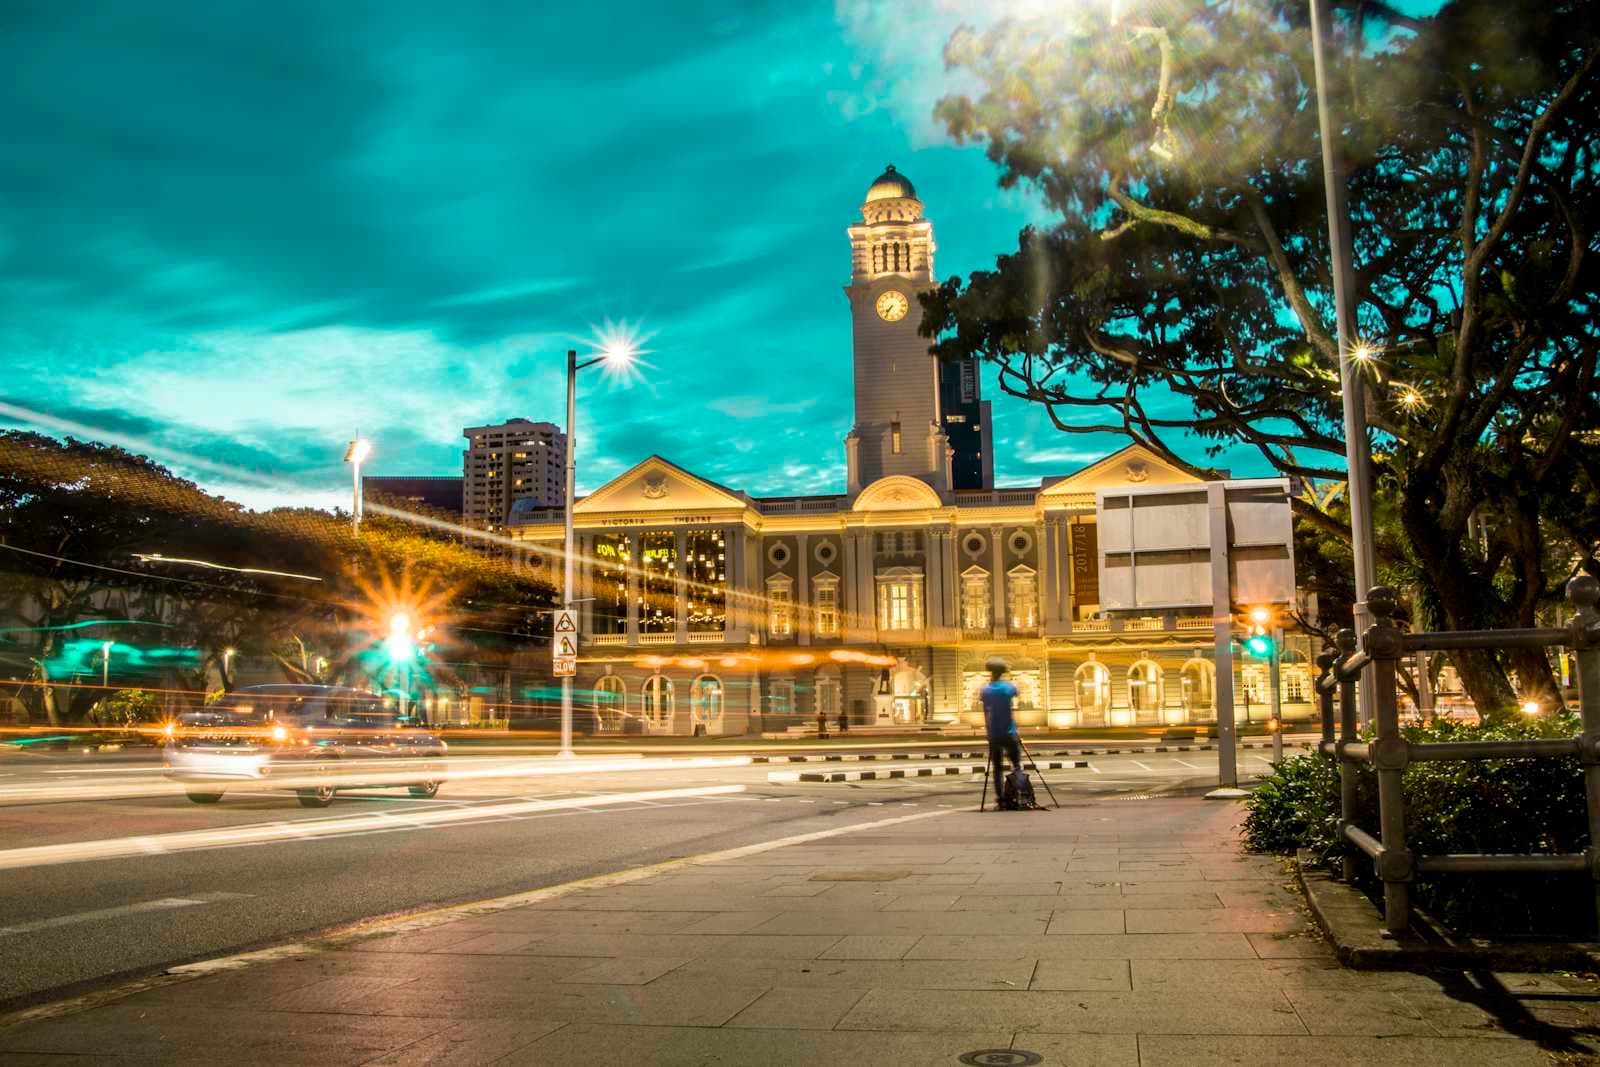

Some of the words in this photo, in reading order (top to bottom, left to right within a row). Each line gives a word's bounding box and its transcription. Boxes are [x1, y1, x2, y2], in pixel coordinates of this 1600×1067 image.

[602, 518, 645, 526] VICTORIA
[1075, 526, 1089, 573] 2017/18
[554, 661, 575, 672] SLOW
